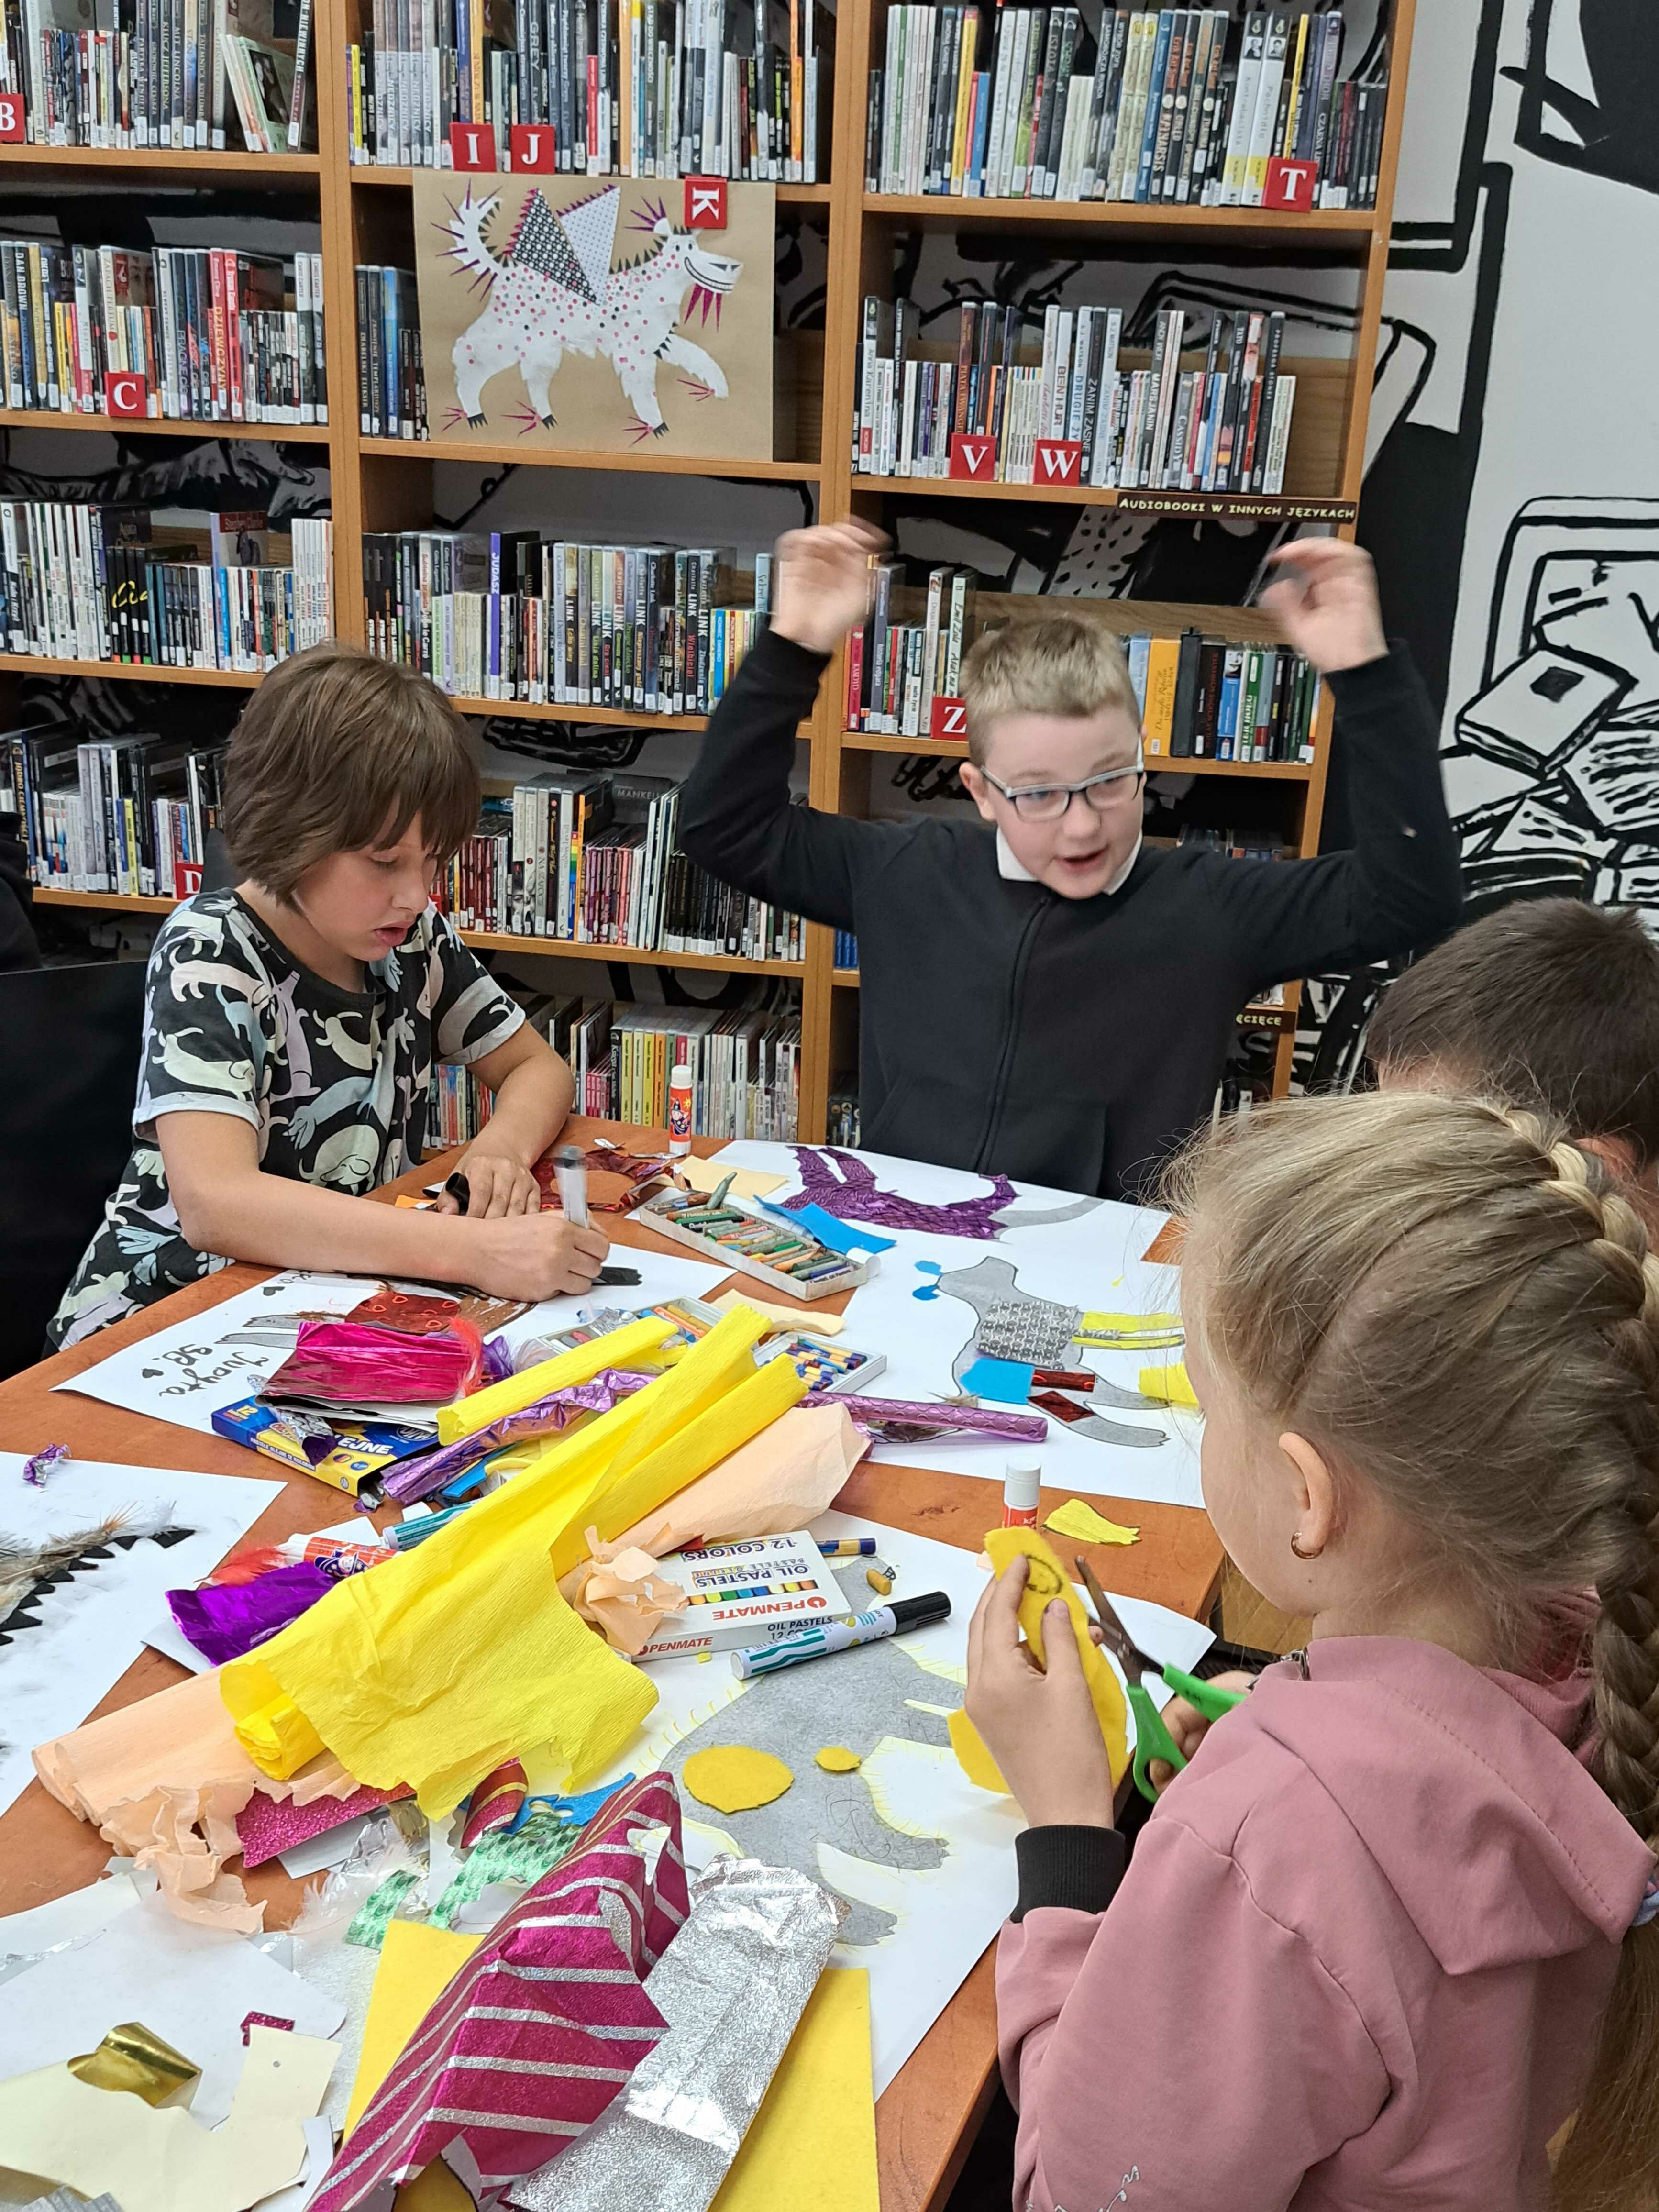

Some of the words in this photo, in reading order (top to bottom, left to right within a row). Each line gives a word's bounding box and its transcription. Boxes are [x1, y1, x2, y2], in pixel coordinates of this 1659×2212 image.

[576, 13, 584, 35] Henry
[647, 25, 654, 38] DO
[1115, 22, 1125, 49] WYBÓR
[530, 22, 540, 71] GREY
[1047, 34, 1058, 72] ISTOTA
[0, 103, 16, 131] B
[465, 133, 481, 164] I
[521, 133, 541, 165] J
[1279, 167, 1308, 201] T
[692, 187, 719, 220] K
[15, 252, 25, 274] DAN
[103, 258, 111, 294] ZAPACH
[16, 276, 27, 310] BROWN
[106, 294, 114, 330] PERFUM
[213, 306, 227, 391] DZIEWCZYNY
[1235, 327, 1245, 344] TATO
[1270, 329, 1281, 368] PROFESOR
[867, 348, 875, 369] Anna
[113, 381, 137, 410] C
[863, 371, 874, 418] Karenina
[1071, 375, 1084, 421] DRUGIE
[1085, 378, 1097, 415] ZANIM
[1145, 373, 1161, 431] MARSJANIN
[1174, 415, 1187, 464] CASSIDY
[961, 444, 989, 474] V
[1040, 448, 1079, 479] W
[1118, 498, 1206, 513] AUDIOBOOKI
[1211, 504, 1224, 513] W
[1228, 504, 1282, 516] INNYCH
[1286, 508, 1355, 519] JĘZYKACH
[491, 552, 500, 595] JUDASZ
[566, 599, 574, 622] LINK
[591, 601, 601, 627] LINK
[613, 603, 624, 631] LINK
[636, 599, 646, 626] LINK
[687, 593, 697, 617] LINK
[954, 602, 963, 622] Emil
[421, 610, 432, 628] John
[602, 611, 612, 638] LINK
[698, 609, 708, 637] LINK
[579, 617, 587, 650] Ostatni
[952, 623, 961, 643] Zola
[876, 643, 885, 665] historia
[949, 652, 959, 674] Atak
[674, 653, 682, 690] milczenie
[874, 666, 884, 686] edgara
[949, 676, 956, 686] na
[942, 706, 967, 733] Z
[182, 870, 202, 894] D
[681, 1541, 765, 1562] COLORS
[771, 1539, 798, 1550] 12
[696, 1568, 772, 1588] PASTELS
[751, 1558, 804, 1571] PASTELE
[780, 1564, 809, 1577] OIL
[712, 1599, 805, 1620] PENMATE
[767, 1622, 786, 1632] OIL
[789, 1616, 833, 1629] PASTELS
[649, 1637, 713, 1653] PENMATE
